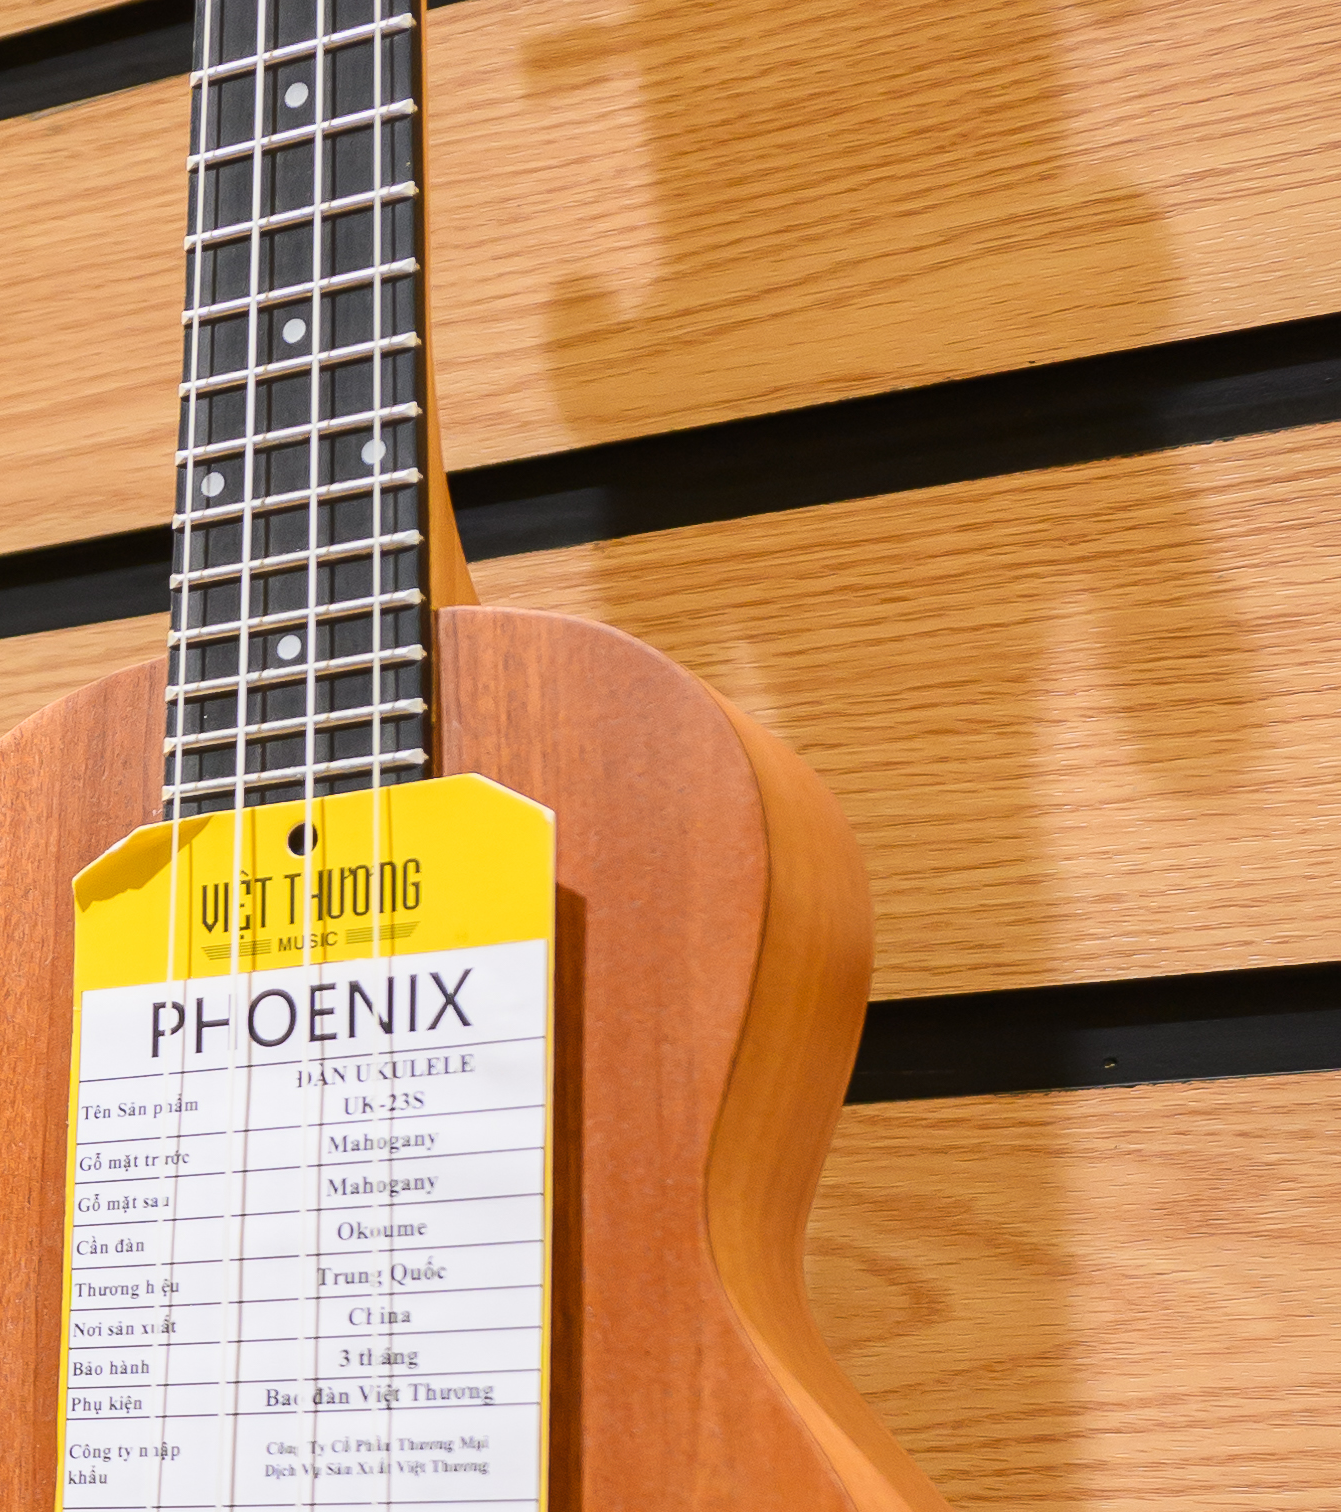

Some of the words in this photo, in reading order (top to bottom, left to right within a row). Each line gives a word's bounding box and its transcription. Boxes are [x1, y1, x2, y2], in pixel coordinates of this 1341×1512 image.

[278, 931, 339, 953] MUSIC
[151, 967, 474, 1058] PHOENIX
[81, 1106, 111, 1120] Tên
[344, 1091, 426, 1115] UK-23S
[327, 1132, 439, 1154] Mahogany
[79, 1152, 102, 1171] Gỗ
[108, 1154, 138, 1172] mặt
[326, 1176, 439, 1197] Mahogany
[78, 1193, 100, 1212] Gỗ
[107, 1196, 137, 1213] mặt
[337, 1221, 427, 1240] Okoume
[76, 1236, 108, 1255] Cần
[115, 1238, 145, 1253] đàn
[390, 1255, 447, 1286] Quốc
[74, 1283, 139, 1299] Thương
[146, 1279, 179, 1297] hệu
[73, 1321, 102, 1337] Nơi
[109, 1360, 150, 1375] hành
[339, 1349, 350, 1367] 3
[71, 1397, 102, 1414] Phụ
[109, 1396, 142, 1413] kiện
[69, 1443, 112, 1462] Công
[118, 1445, 133, 1461] ty
[68, 1465, 108, 1485] khẩu
